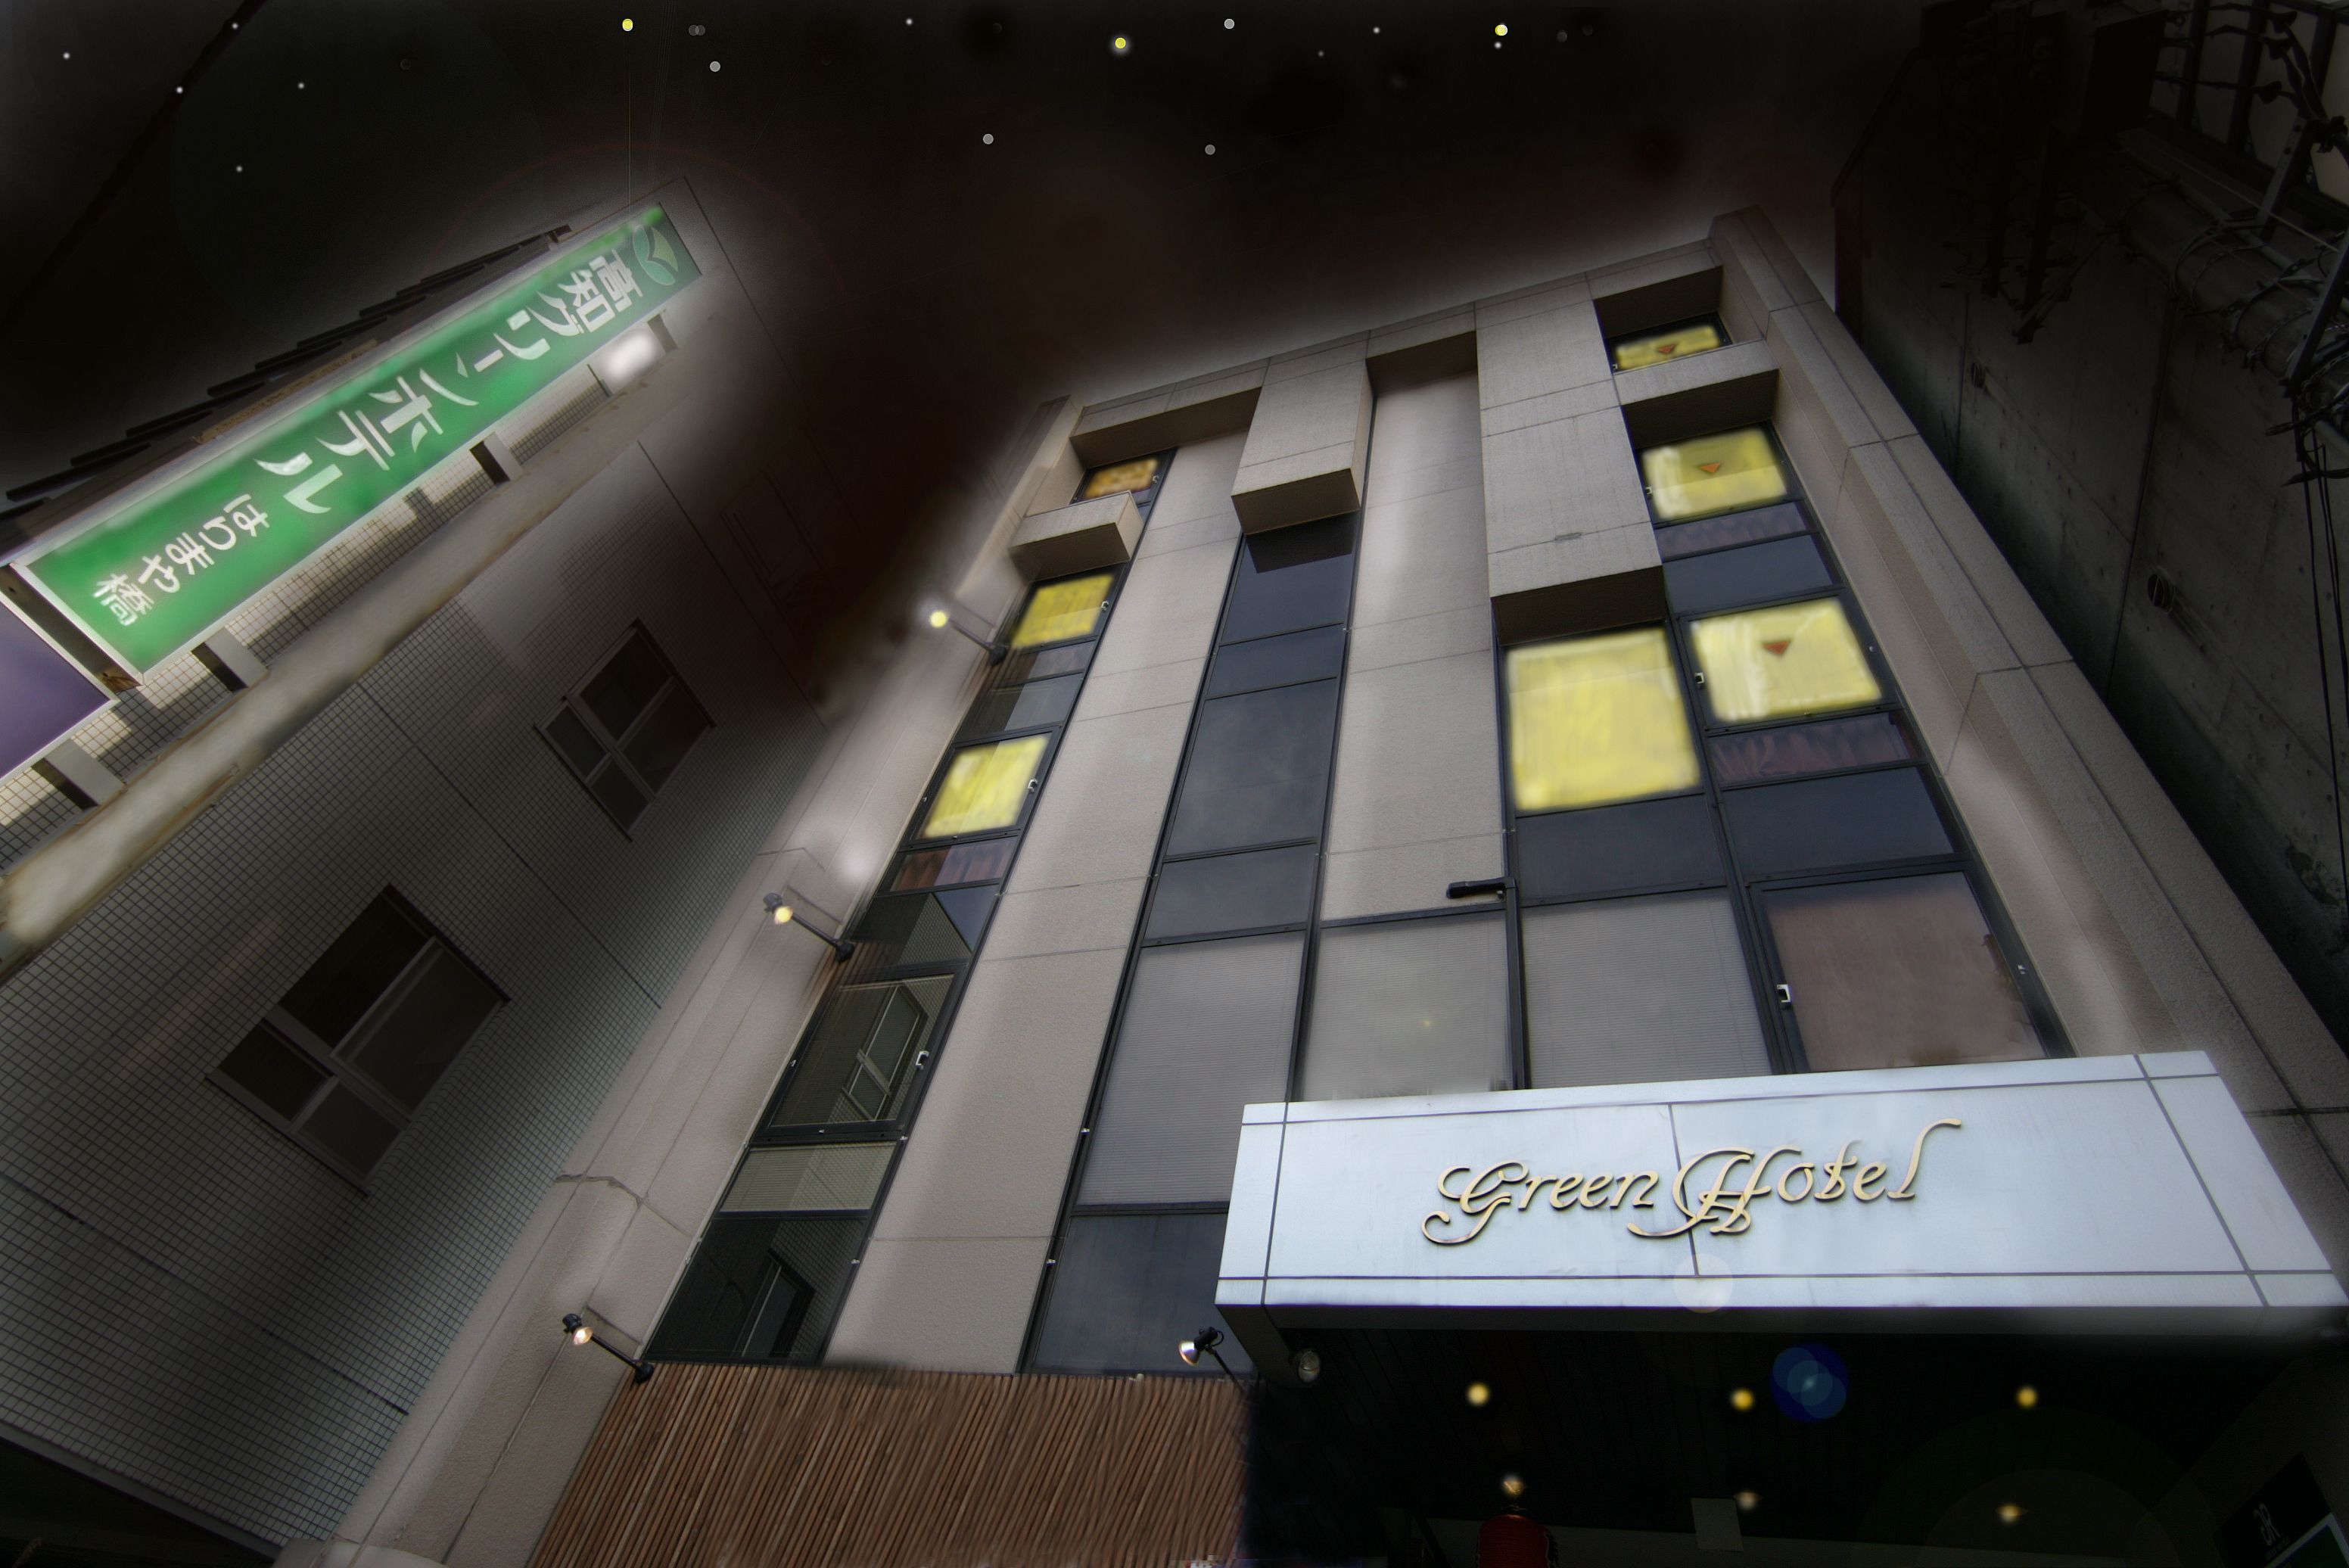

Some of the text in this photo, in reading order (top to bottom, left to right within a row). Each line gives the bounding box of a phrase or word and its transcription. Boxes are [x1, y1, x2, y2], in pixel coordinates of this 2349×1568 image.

[92, 249, 643, 627] 高知グリーンホテル はりまや橋
[1420, 1118, 1963, 1245] Green Hotel
